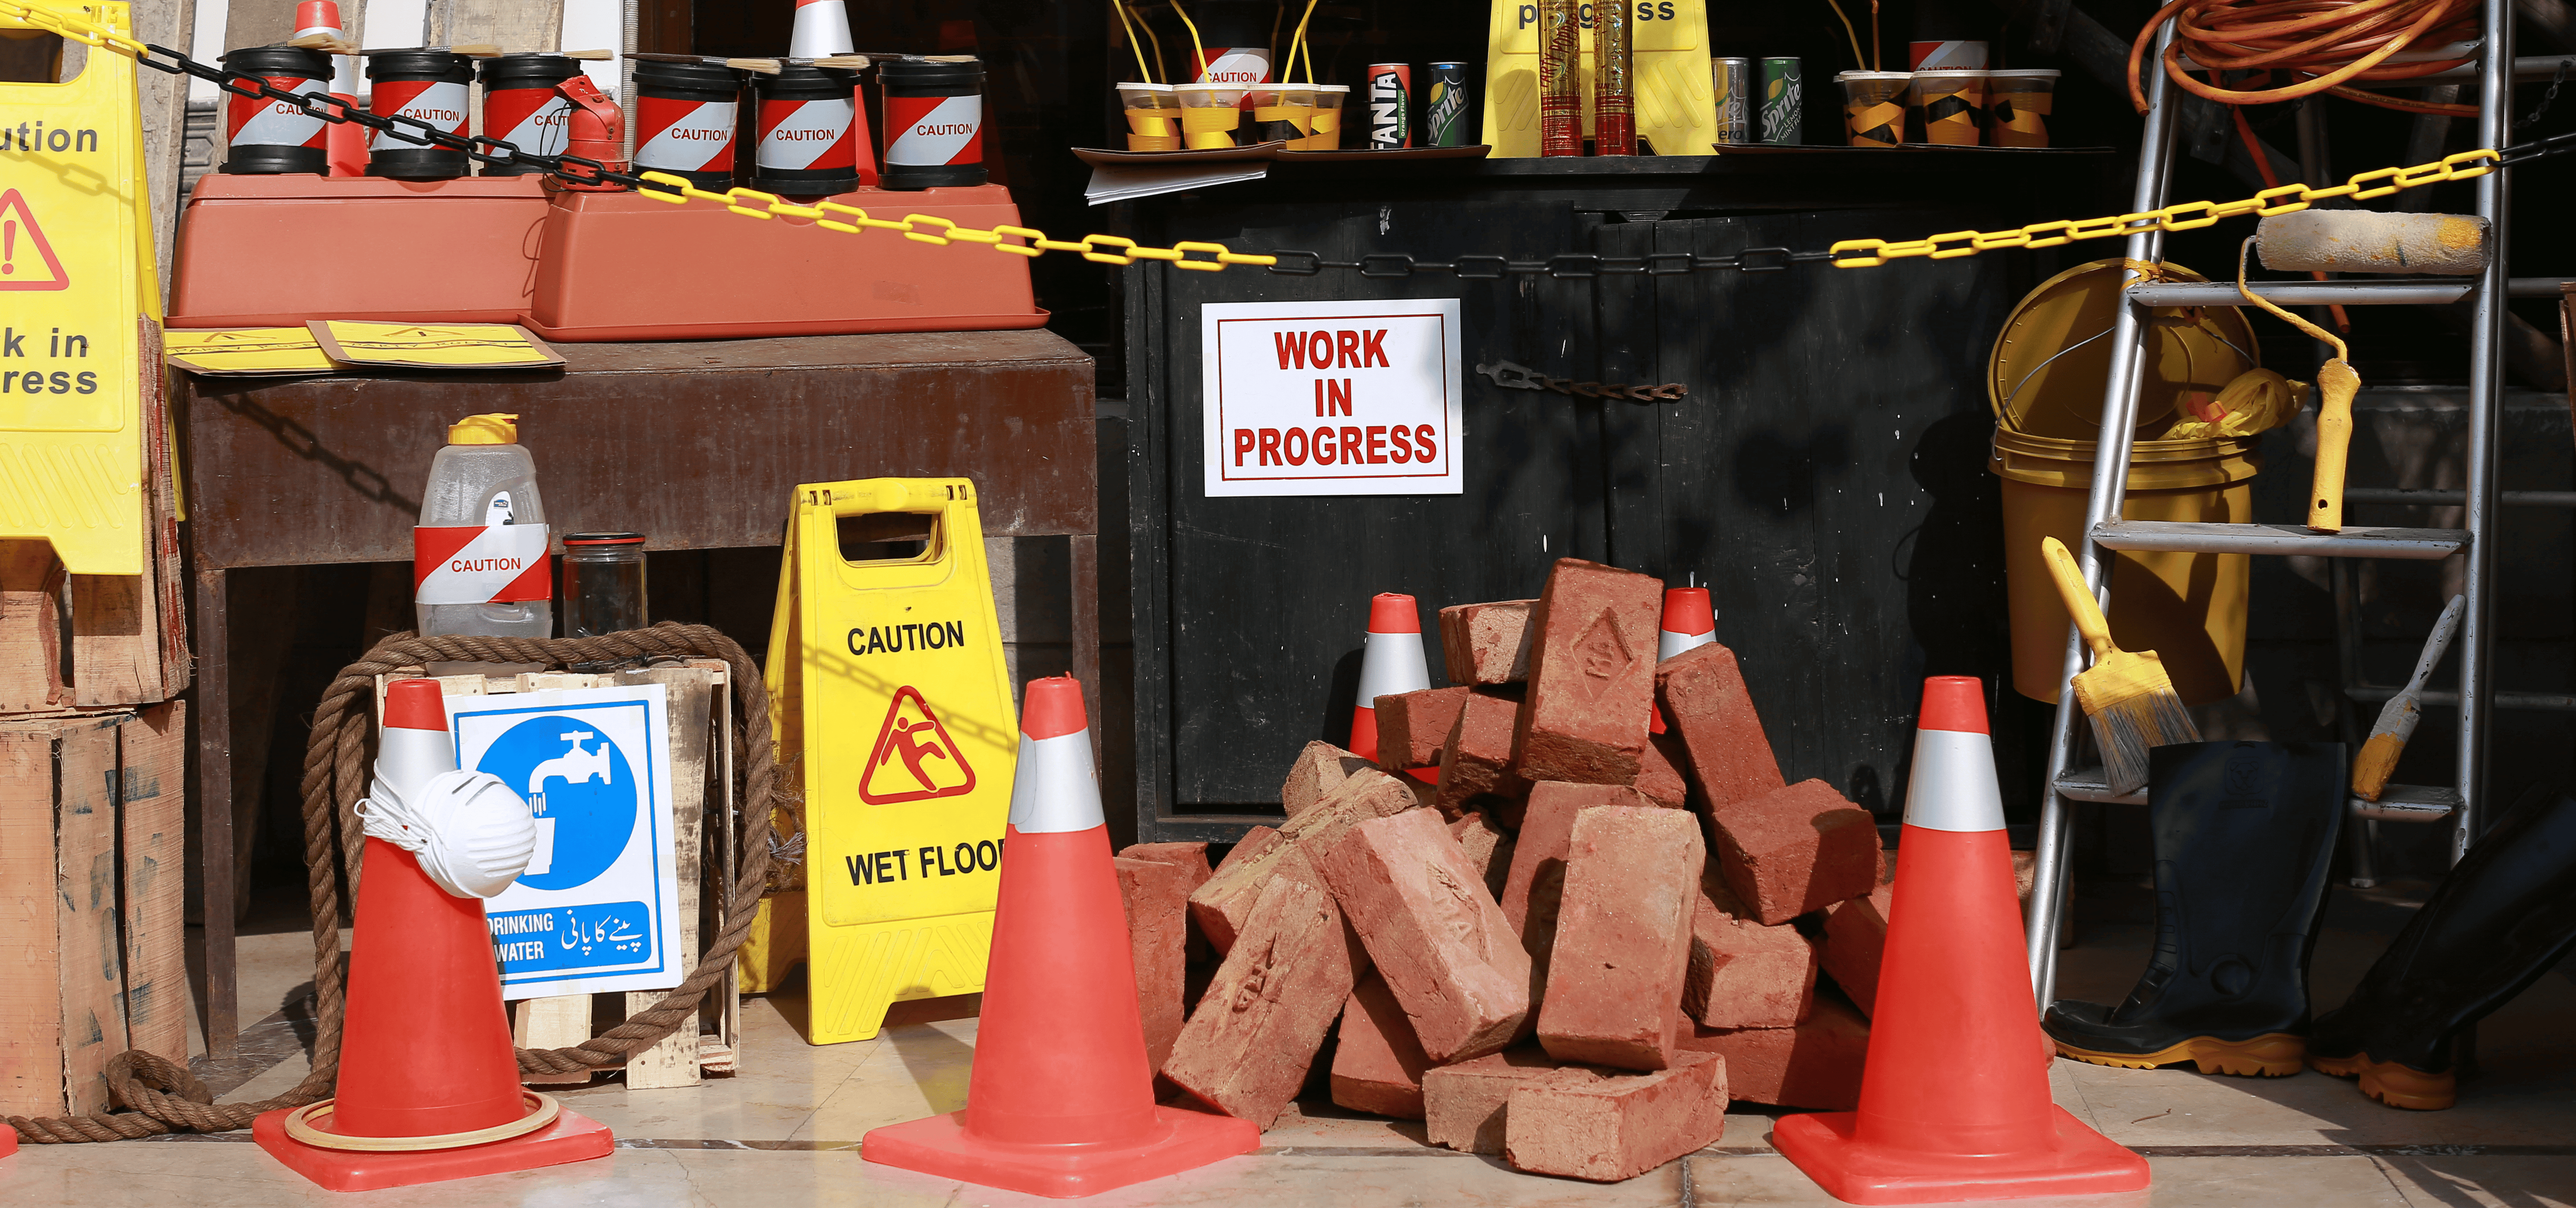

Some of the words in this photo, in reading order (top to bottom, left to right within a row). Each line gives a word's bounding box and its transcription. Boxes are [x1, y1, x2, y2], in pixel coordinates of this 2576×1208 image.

[1519, 1, 1675, 30] pgss
[404, 109, 459, 122] CAUTION
[1428, 86, 1465, 142] Sprite
[1762, 83, 1801, 138] Sprite
[1784, 106, 1800, 128] LEMON
[671, 128, 728, 141] CAUTION
[776, 129, 835, 141] CAUTION
[917, 123, 972, 136] CAUTION
[1718, 130, 1743, 140] ero
[1780, 123, 1795, 140] MINT
[50, 327, 88, 357] in
[1274, 329, 1390, 370] WORK
[3, 371, 97, 395] ress
[1315, 378, 1352, 417] IN
[1234, 424, 1437, 467] PROGRESS
[452, 557, 521, 573] CAUTION
[847, 621, 964, 656] CAUTION
[846, 849, 910, 886] WET
[561, 909, 593, 957] پانی
[595, 915, 612, 943] کا
[608, 918, 643, 953] پینے
[493, 940, 545, 963] WATER
